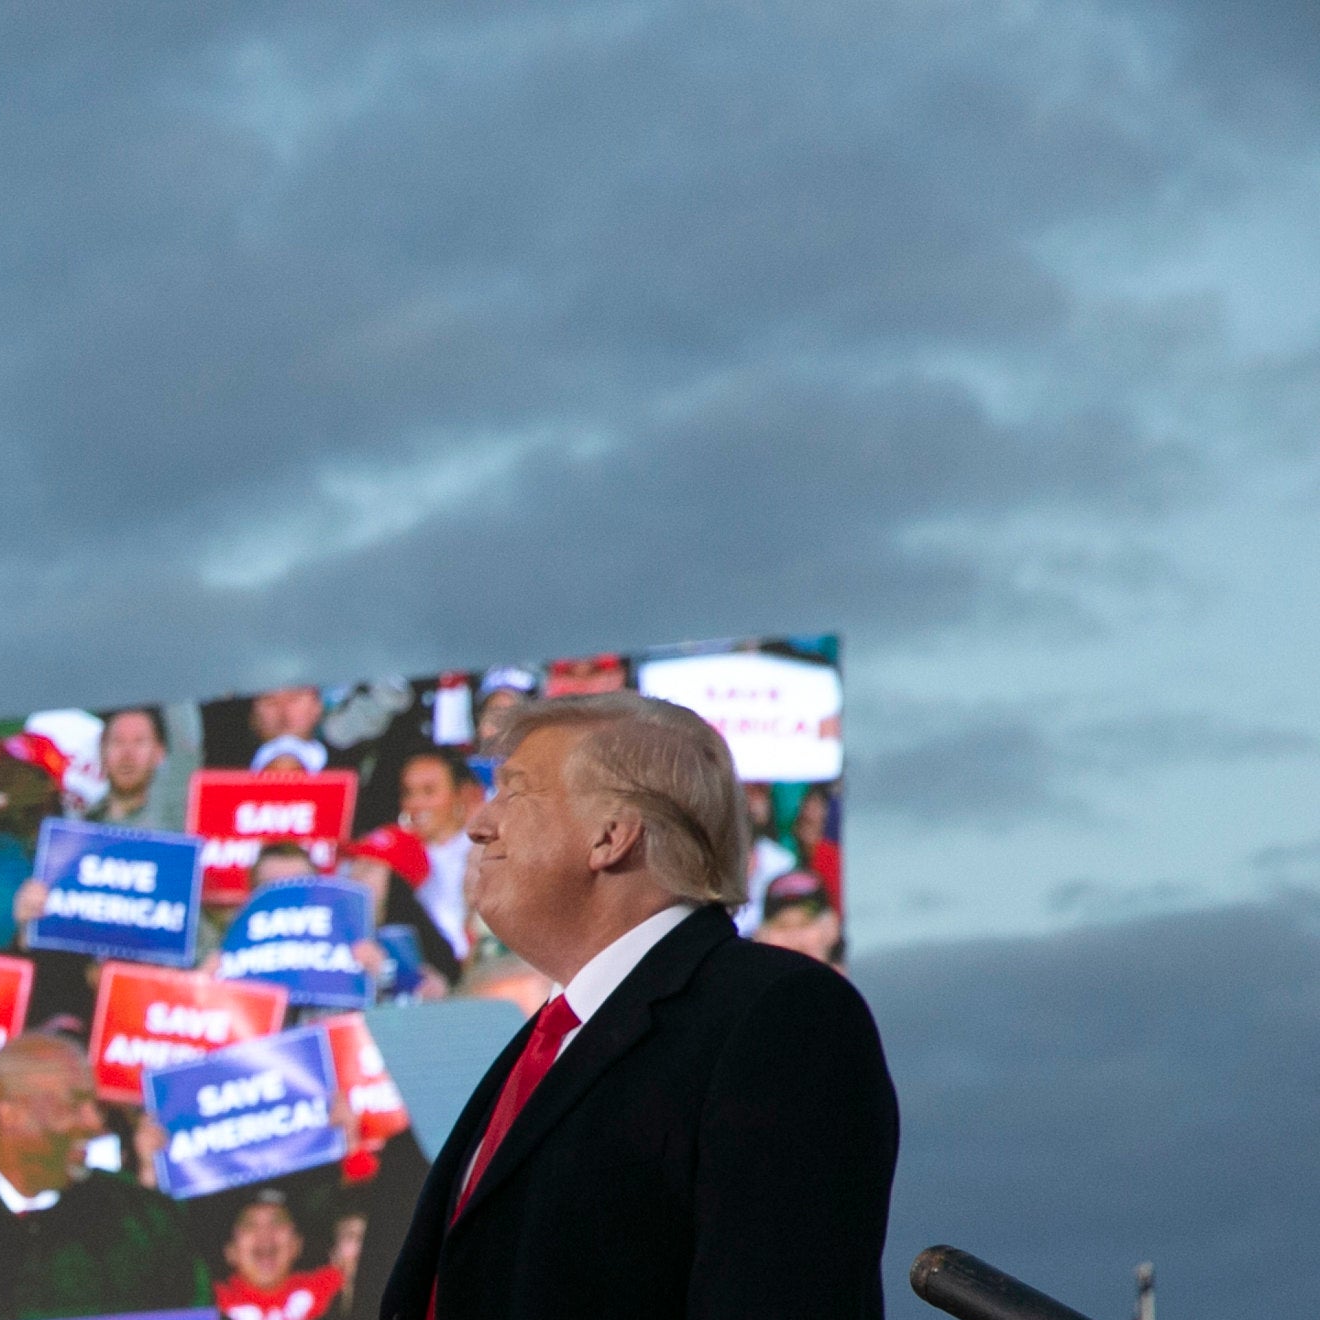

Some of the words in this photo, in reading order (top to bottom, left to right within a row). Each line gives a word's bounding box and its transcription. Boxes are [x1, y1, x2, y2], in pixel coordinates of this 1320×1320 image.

[234, 800, 316, 835] SAVE
[78, 854, 158, 893] SAVE
[45, 887, 187, 932] AMERICA!
[246, 905, 333, 942] SAVE
[144, 1002, 231, 1043] SAVE
[196, 1068, 286, 1118] SAVE
[169, 1098, 329, 1163] AMERICA!
